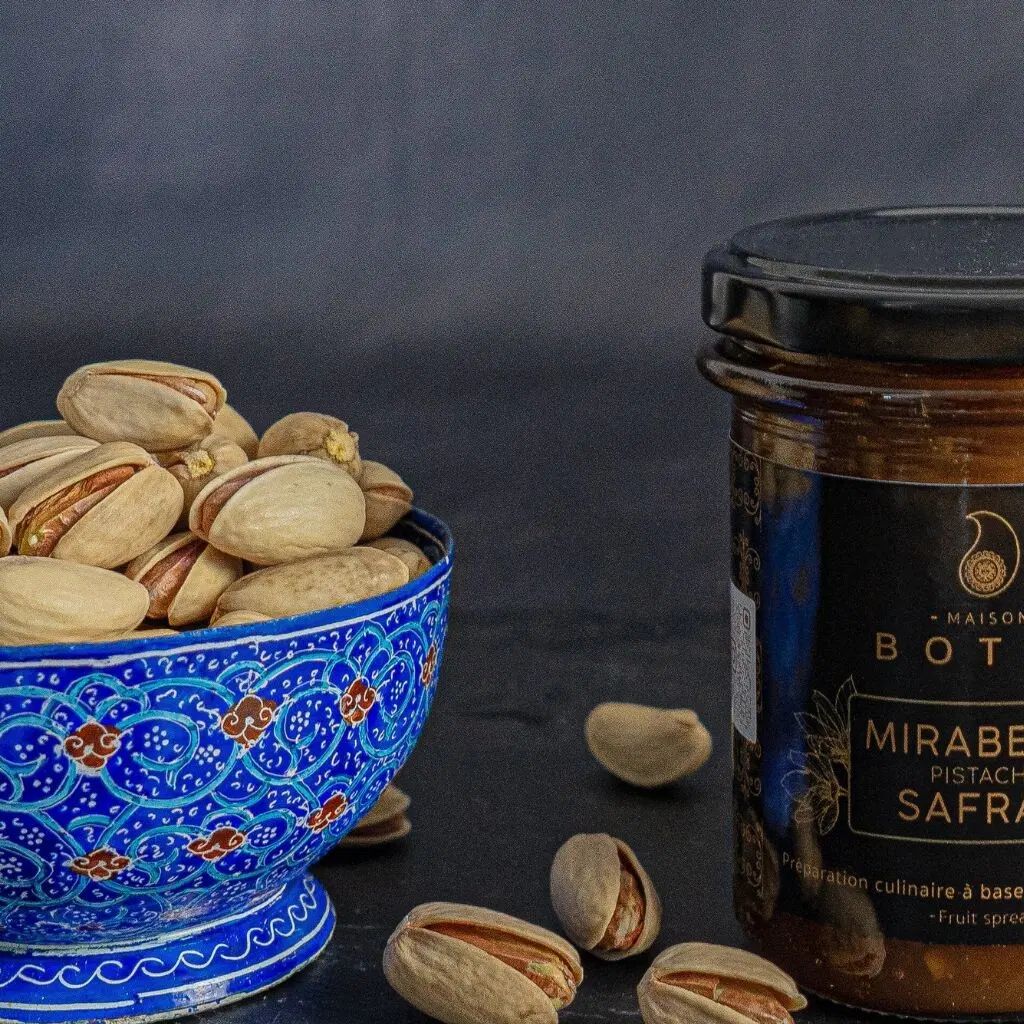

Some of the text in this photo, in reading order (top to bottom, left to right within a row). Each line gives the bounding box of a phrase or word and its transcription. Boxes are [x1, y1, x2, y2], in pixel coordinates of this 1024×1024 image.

[781, 851, 869, 890] Préparation
[874, 878, 955, 900] culinaire
[962, 882, 973, 900] à
[980, 883, 1024, 900] base
